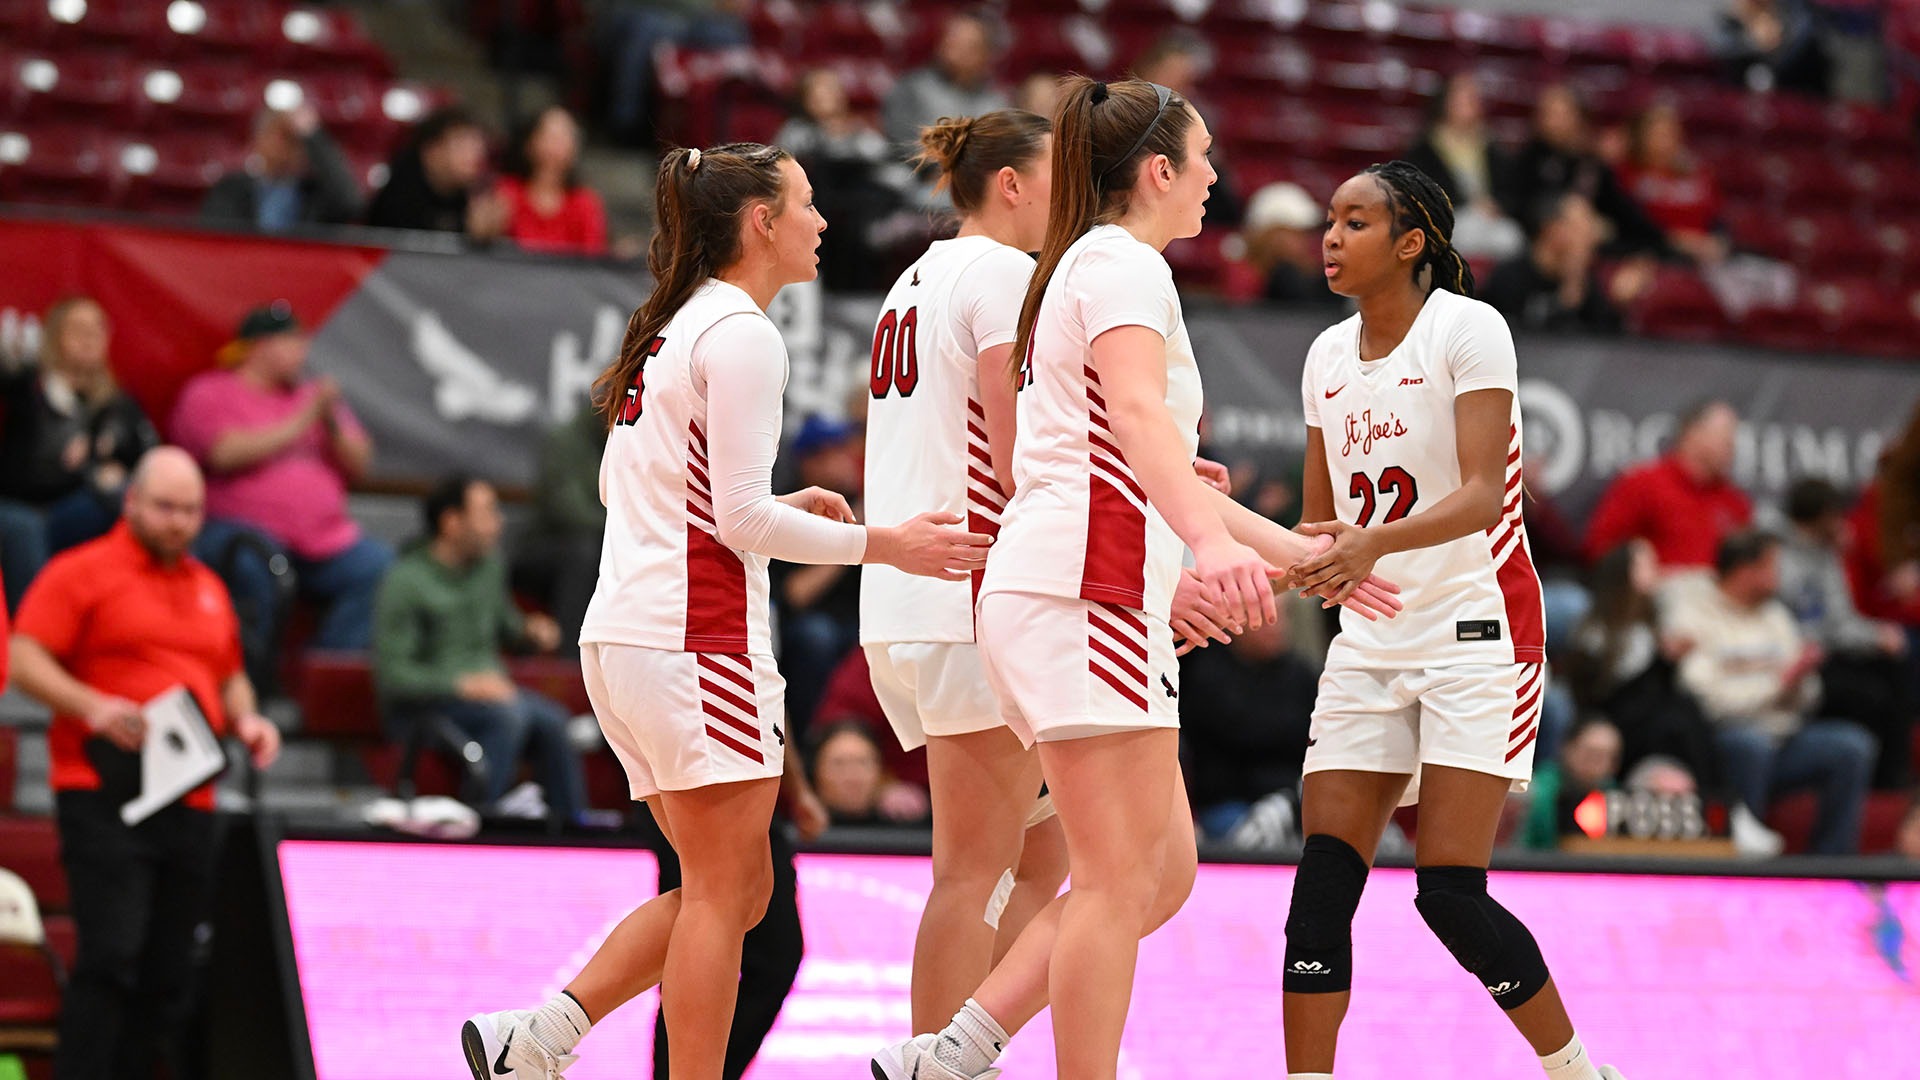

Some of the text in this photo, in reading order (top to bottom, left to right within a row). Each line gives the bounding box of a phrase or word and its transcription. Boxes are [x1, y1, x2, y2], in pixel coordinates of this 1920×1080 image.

[616, 336, 667, 426] 5
[870, 306, 919, 399] 00
[1362, 408, 1408, 455] Joe's
[1350, 465, 1419, 529] 22
[1487, 625, 1495, 634] M
